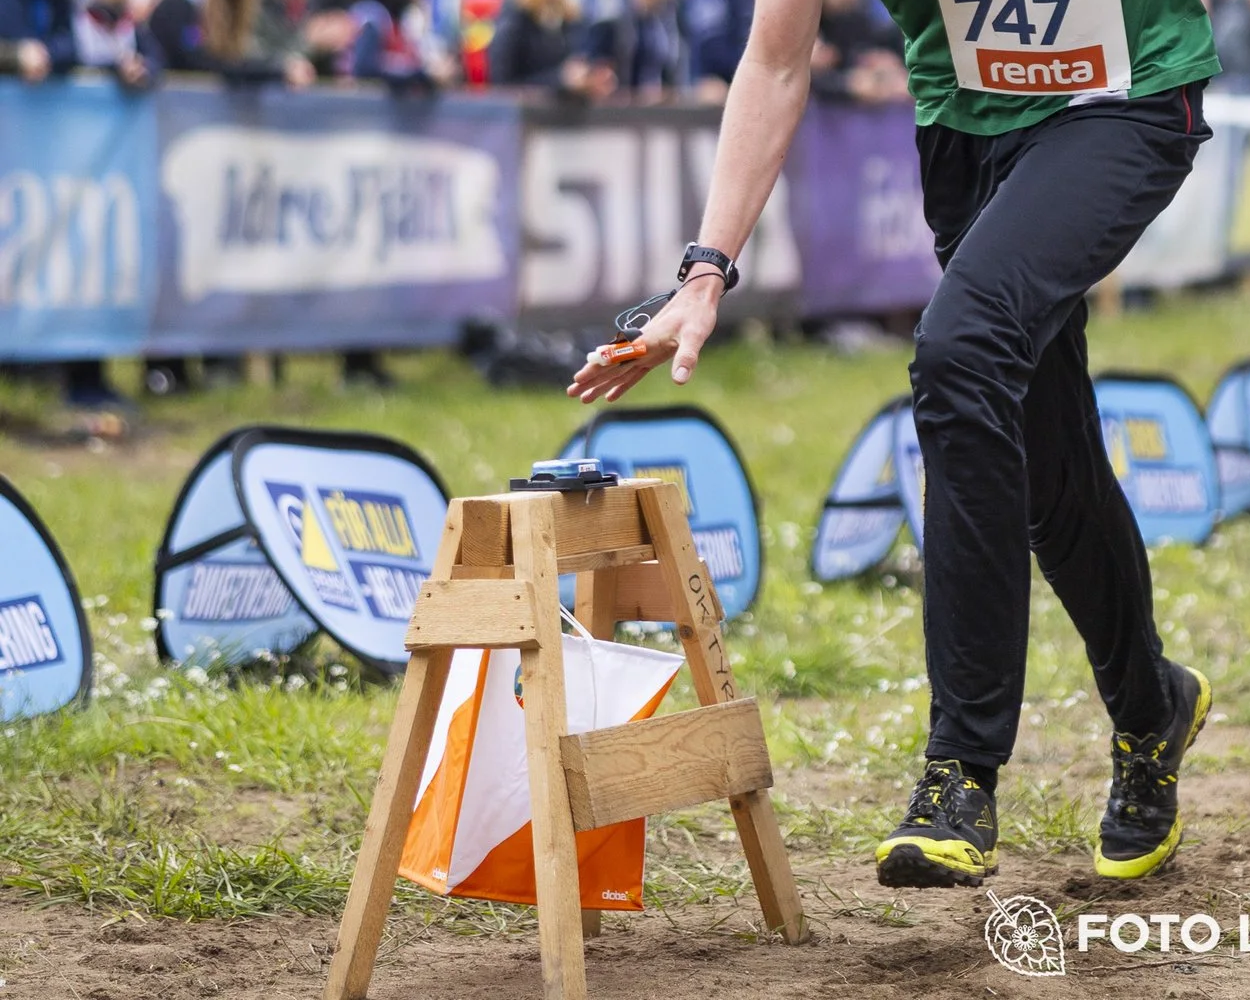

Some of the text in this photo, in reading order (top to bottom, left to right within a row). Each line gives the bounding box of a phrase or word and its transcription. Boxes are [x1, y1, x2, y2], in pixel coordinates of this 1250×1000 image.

[989, 58, 1094, 86] renta
[324, 490, 419, 558] FÖR ALLA
[688, 574, 734, 701] OK TYR
